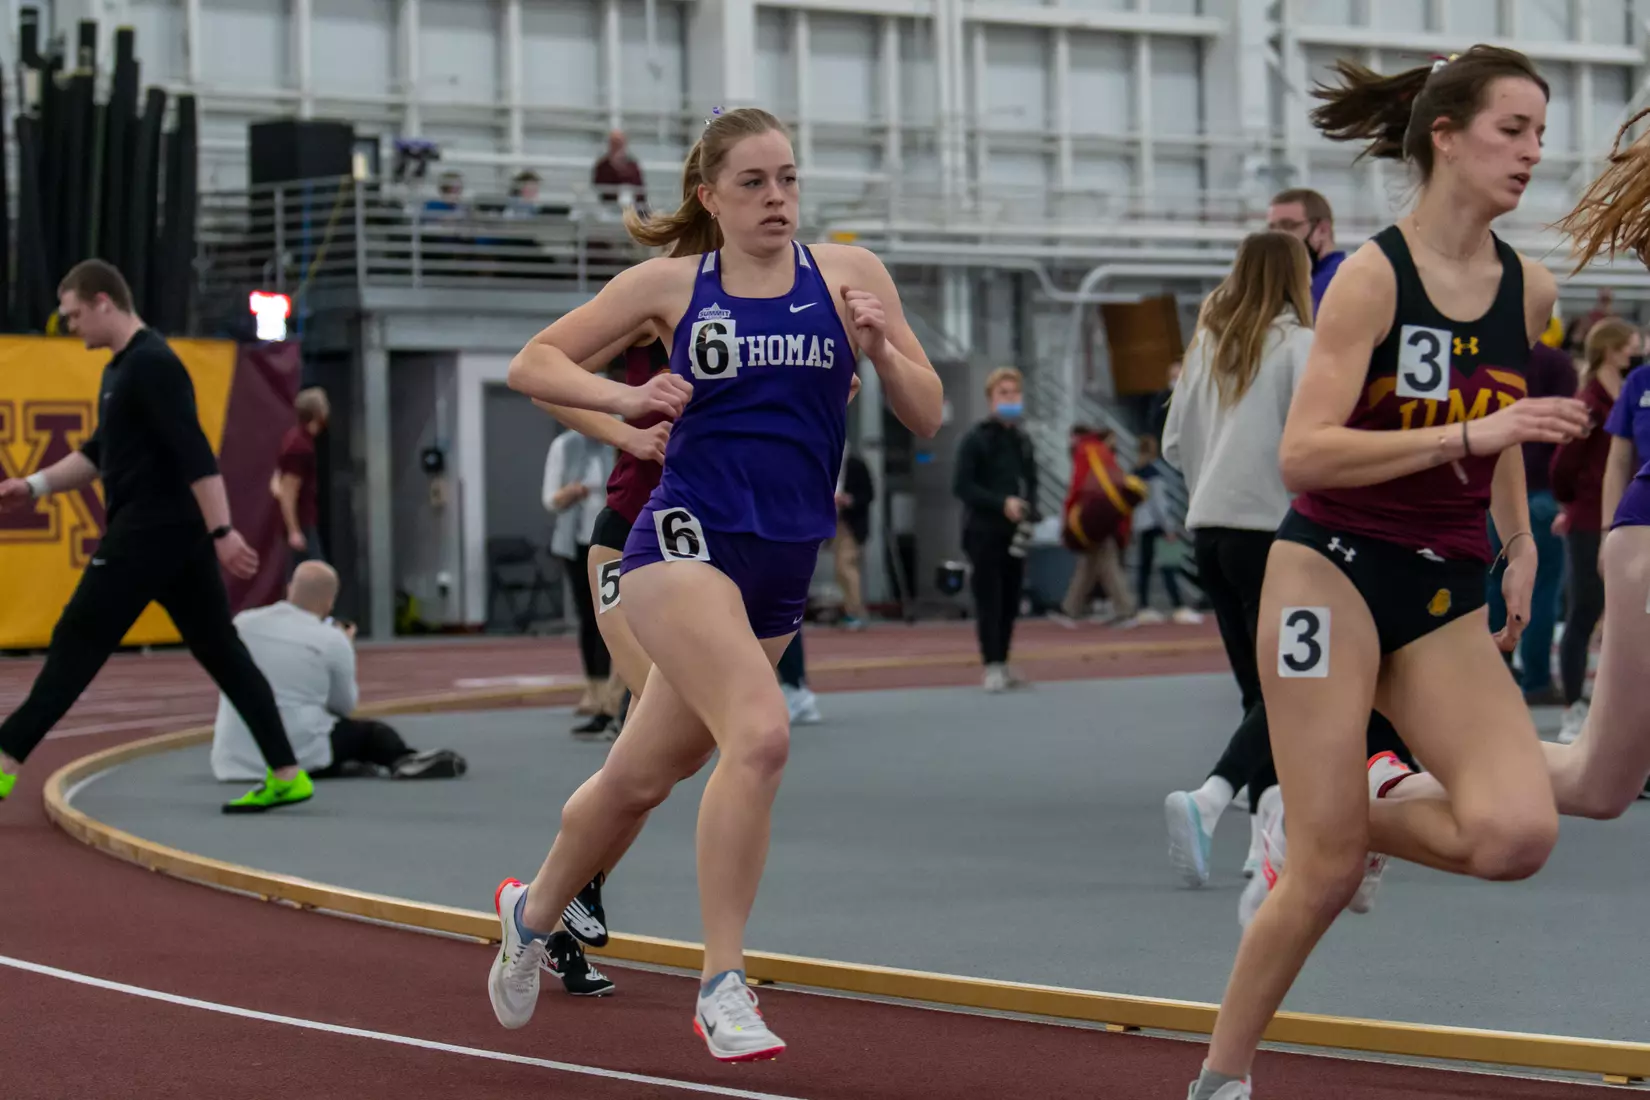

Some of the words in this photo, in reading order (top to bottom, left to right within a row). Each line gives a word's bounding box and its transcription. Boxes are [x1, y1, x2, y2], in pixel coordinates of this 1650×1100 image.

[696, 322, 729, 375] 6
[1403, 330, 1442, 392] 3
[662, 511, 700, 558] 6
[601, 561, 621, 605] 5
[1283, 610, 1321, 672] 3
